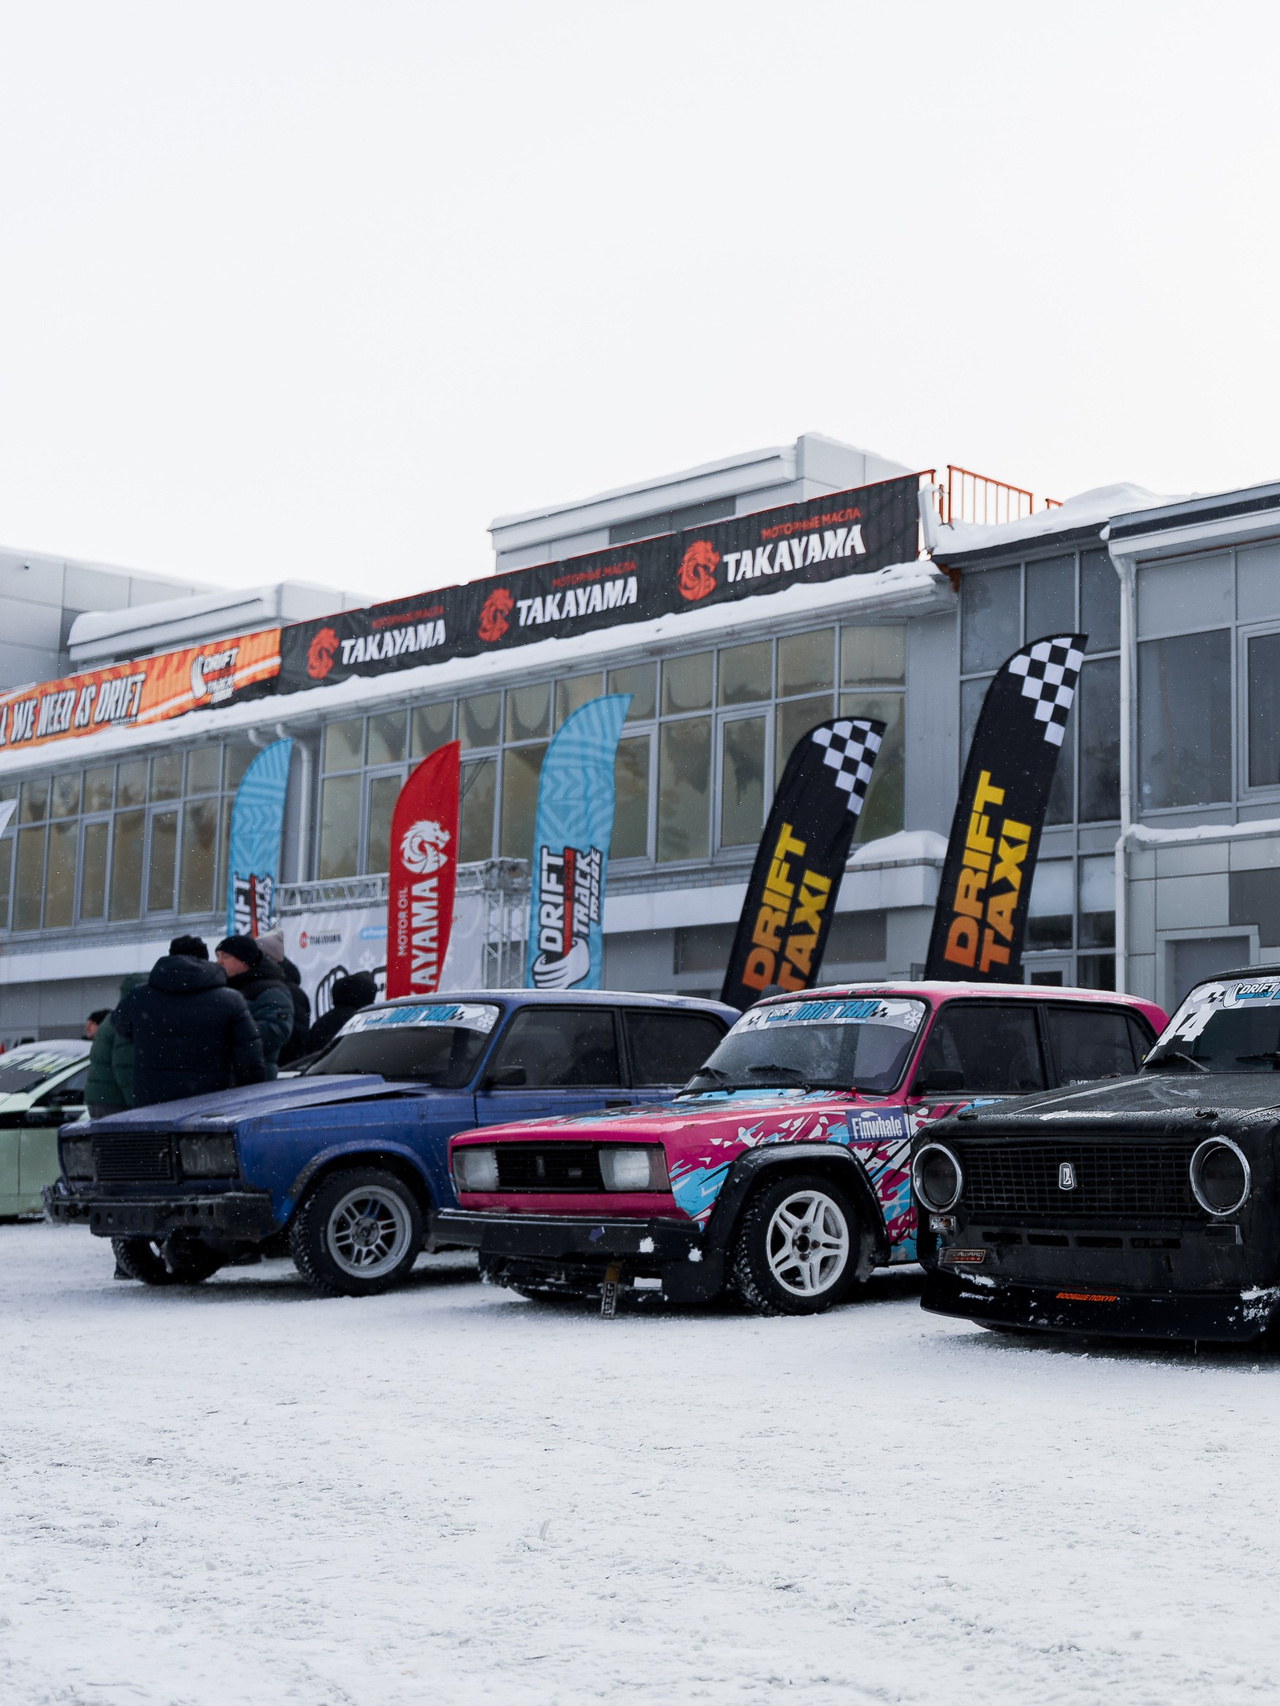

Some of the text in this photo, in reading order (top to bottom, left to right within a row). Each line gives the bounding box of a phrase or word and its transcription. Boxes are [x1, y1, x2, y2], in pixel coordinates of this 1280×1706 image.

[723, 524, 867, 583] TAKAYAMA
[761, 506, 861, 541] МОТОРНЫЕ МАСЛА
[516, 576, 638, 627] TAKAYAMA
[340, 619, 447, 665] TAKAYAMA
[10, 697, 38, 743] WE
[36, 689, 77, 738] NEED
[74, 683, 97, 729] IS
[94, 672, 146, 723] DRIFT
[539, 847, 565, 953] DRIFT
[944, 770, 1005, 968] DRIFT
[979, 819, 1031, 973] TAXI
[233, 872, 251, 937] RIFT
[397, 886, 409, 957] MOTOR OIL
[411, 878, 438, 994] AYAMA
[742, 822, 806, 991] DRIFT
[777, 869, 832, 992] TAXI
[789, 1001, 882, 1022] DRIFT TAXI
[1239, 982, 1280, 994] DRIFT
[851, 1115, 903, 1139] Finwhale
